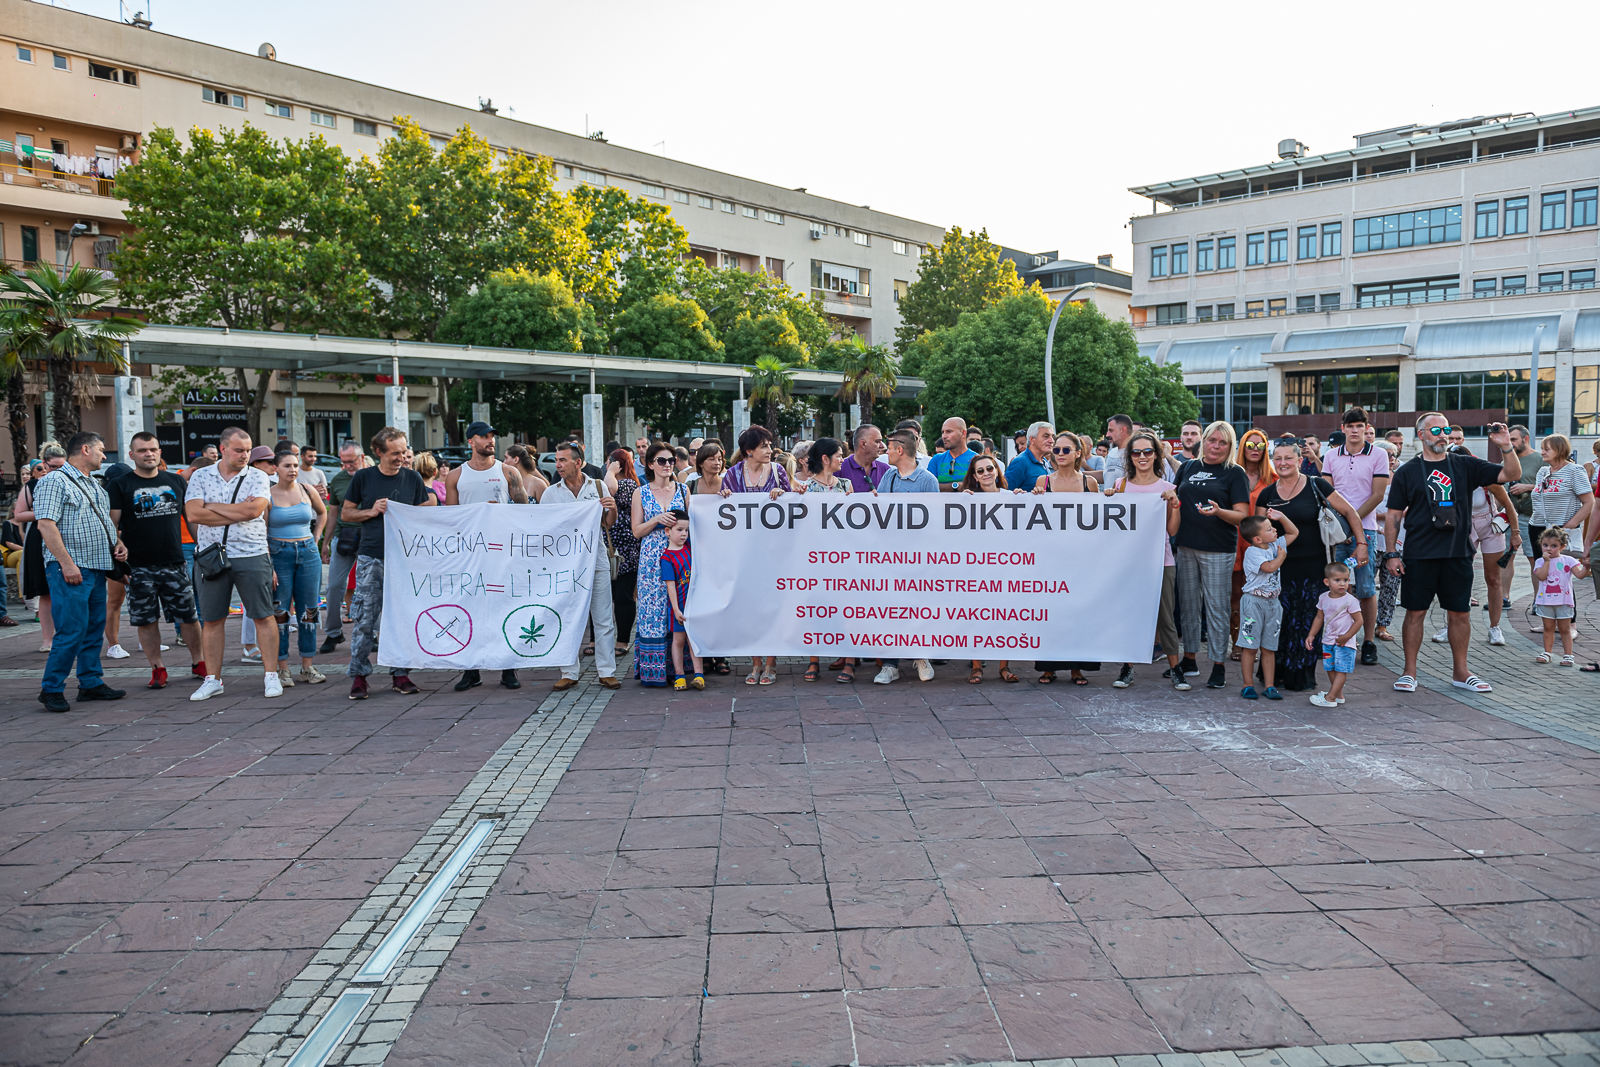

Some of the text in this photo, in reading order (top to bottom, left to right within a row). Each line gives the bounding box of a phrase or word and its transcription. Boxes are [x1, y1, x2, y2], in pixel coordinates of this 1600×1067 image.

[717, 502, 1137, 531] STOP KOVID DIKTATURI
[808, 550, 1036, 567] STOP TIRANIJI NAD DJECOM
[776, 577, 1070, 594] STOP TIRANIJI MAINSTREAM MEDIJA
[795, 605, 1049, 622] STOP OBAVEZNOJ VAKCINACIJI
[802, 632, 1041, 649] STOP VAKCINALNOM PASOŠU
